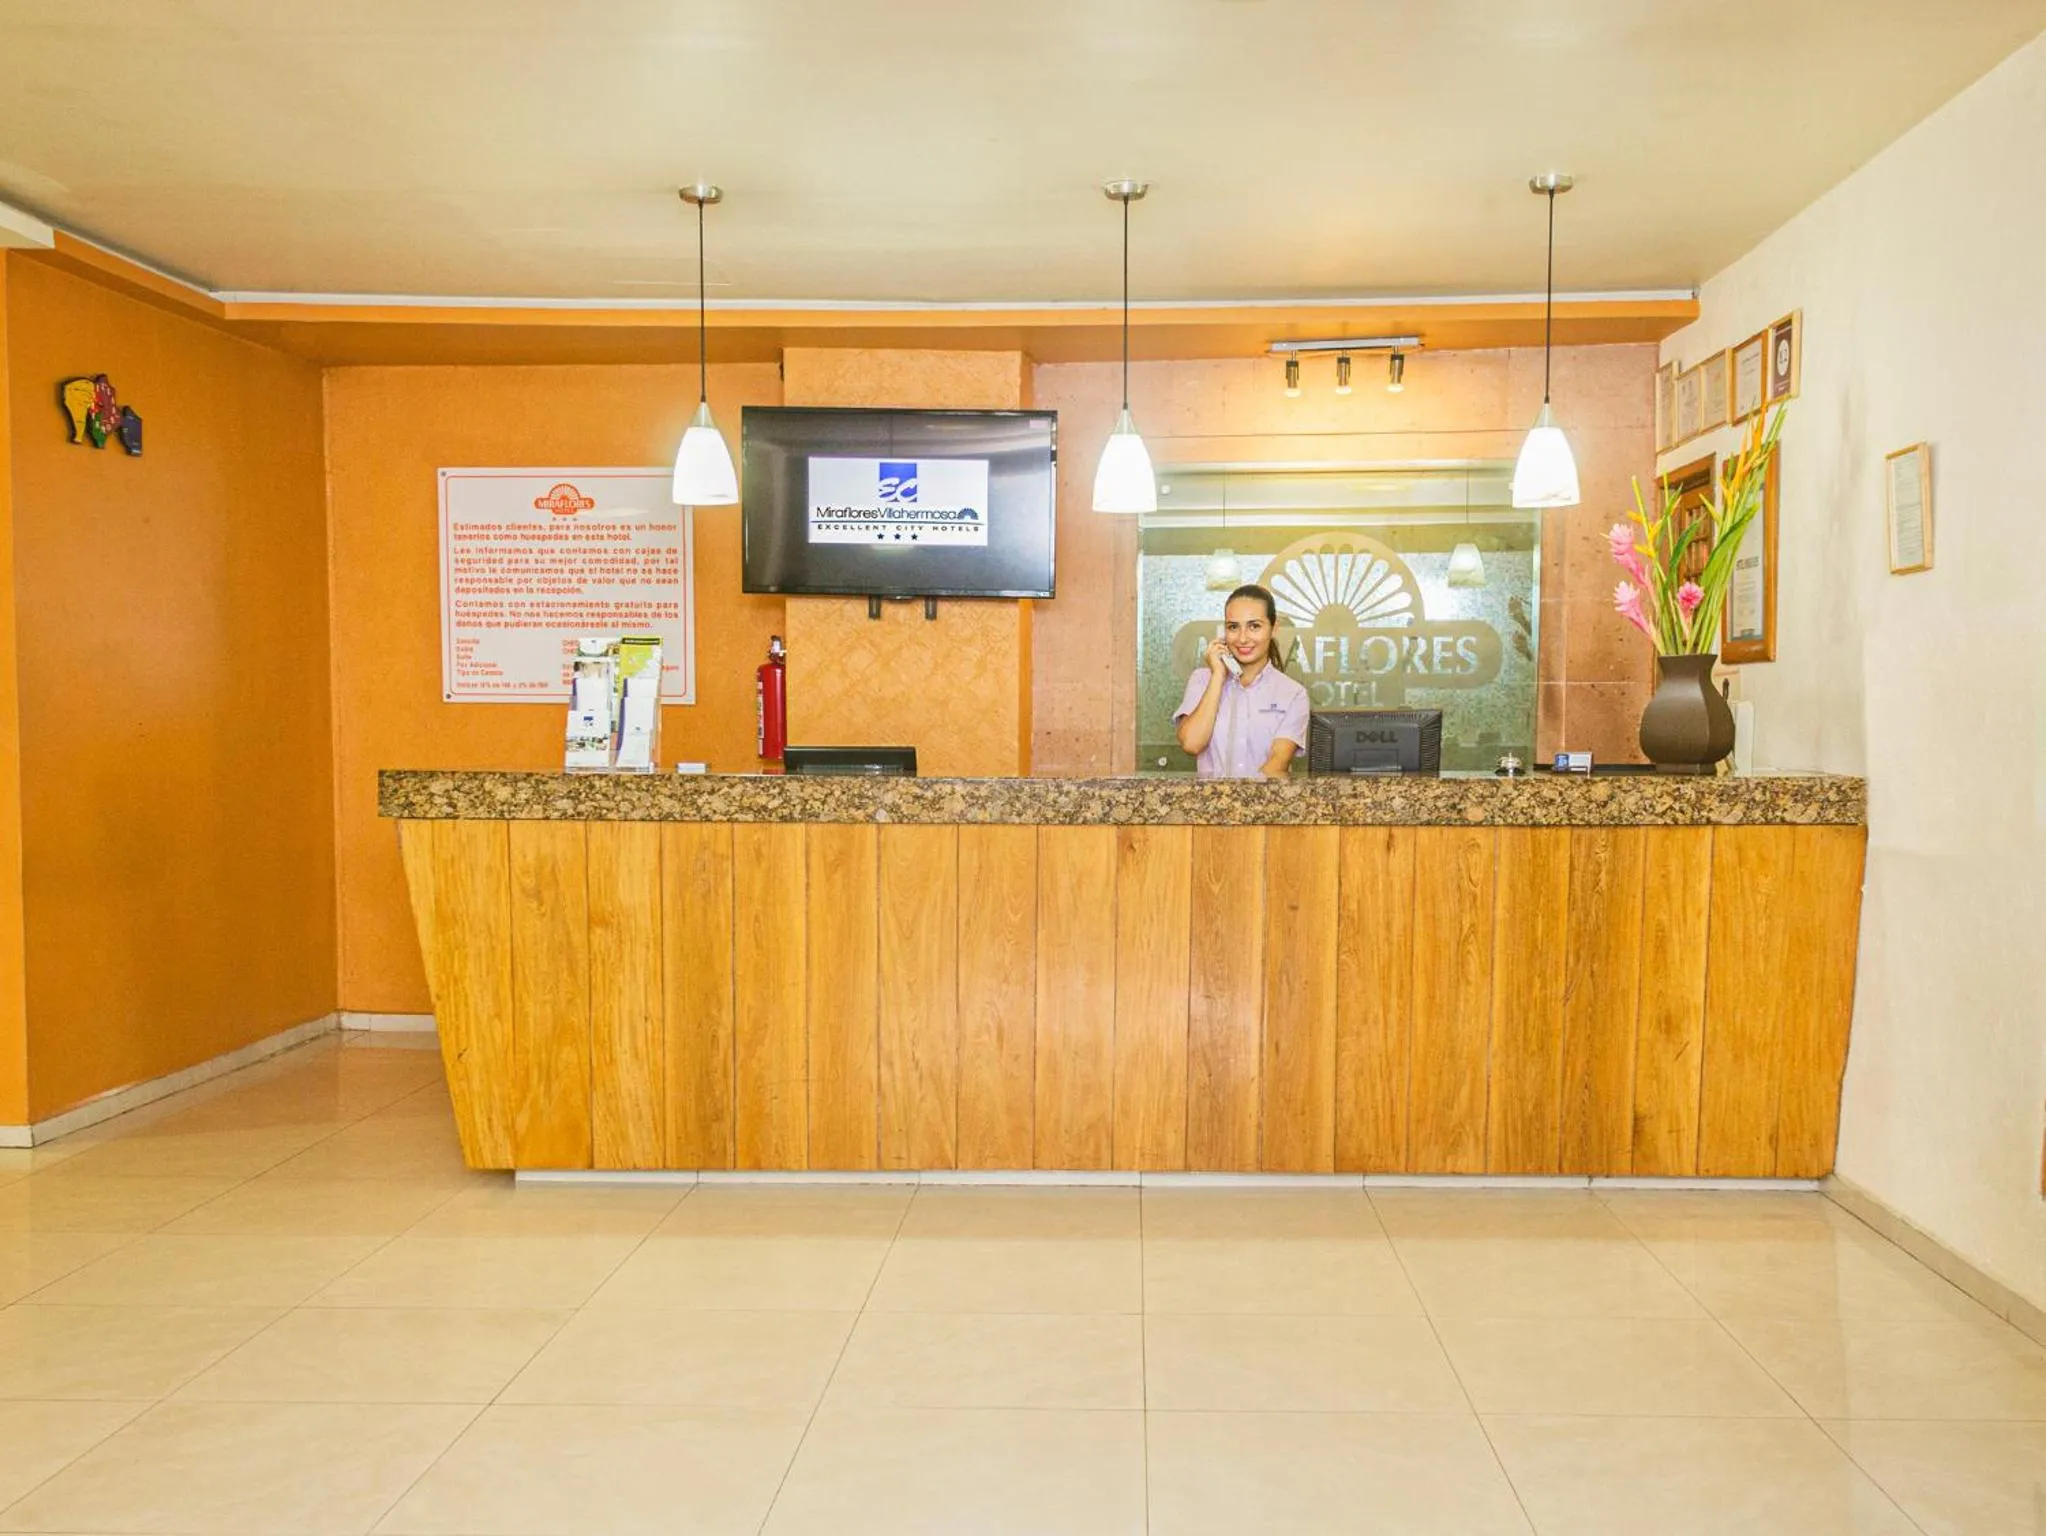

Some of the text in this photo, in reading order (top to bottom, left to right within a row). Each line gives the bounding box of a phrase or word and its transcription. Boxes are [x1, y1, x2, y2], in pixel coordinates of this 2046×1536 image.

[538, 499, 591, 508] MIRAFLORES
[549, 524, 570, 532] para
[817, 524, 887, 532] EXCELLENT
[537, 548, 555, 556] que
[635, 548, 661, 556] cajas
[454, 557, 503, 565] seguridad
[550, 558, 576, 566] mejor
[582, 557, 640, 565] comodidad,
[455, 577, 513, 585] responsable
[537, 577, 572, 585] objetos
[455, 586, 510, 594] depositados
[455, 600, 503, 608] Contamos
[614, 601, 652, 610] gratuito
[656, 602, 678, 610] para
[504, 620, 543, 628] pudieran
[1311, 681, 1385, 708] OTEL
[1355, 730, 1399, 744] DELL
